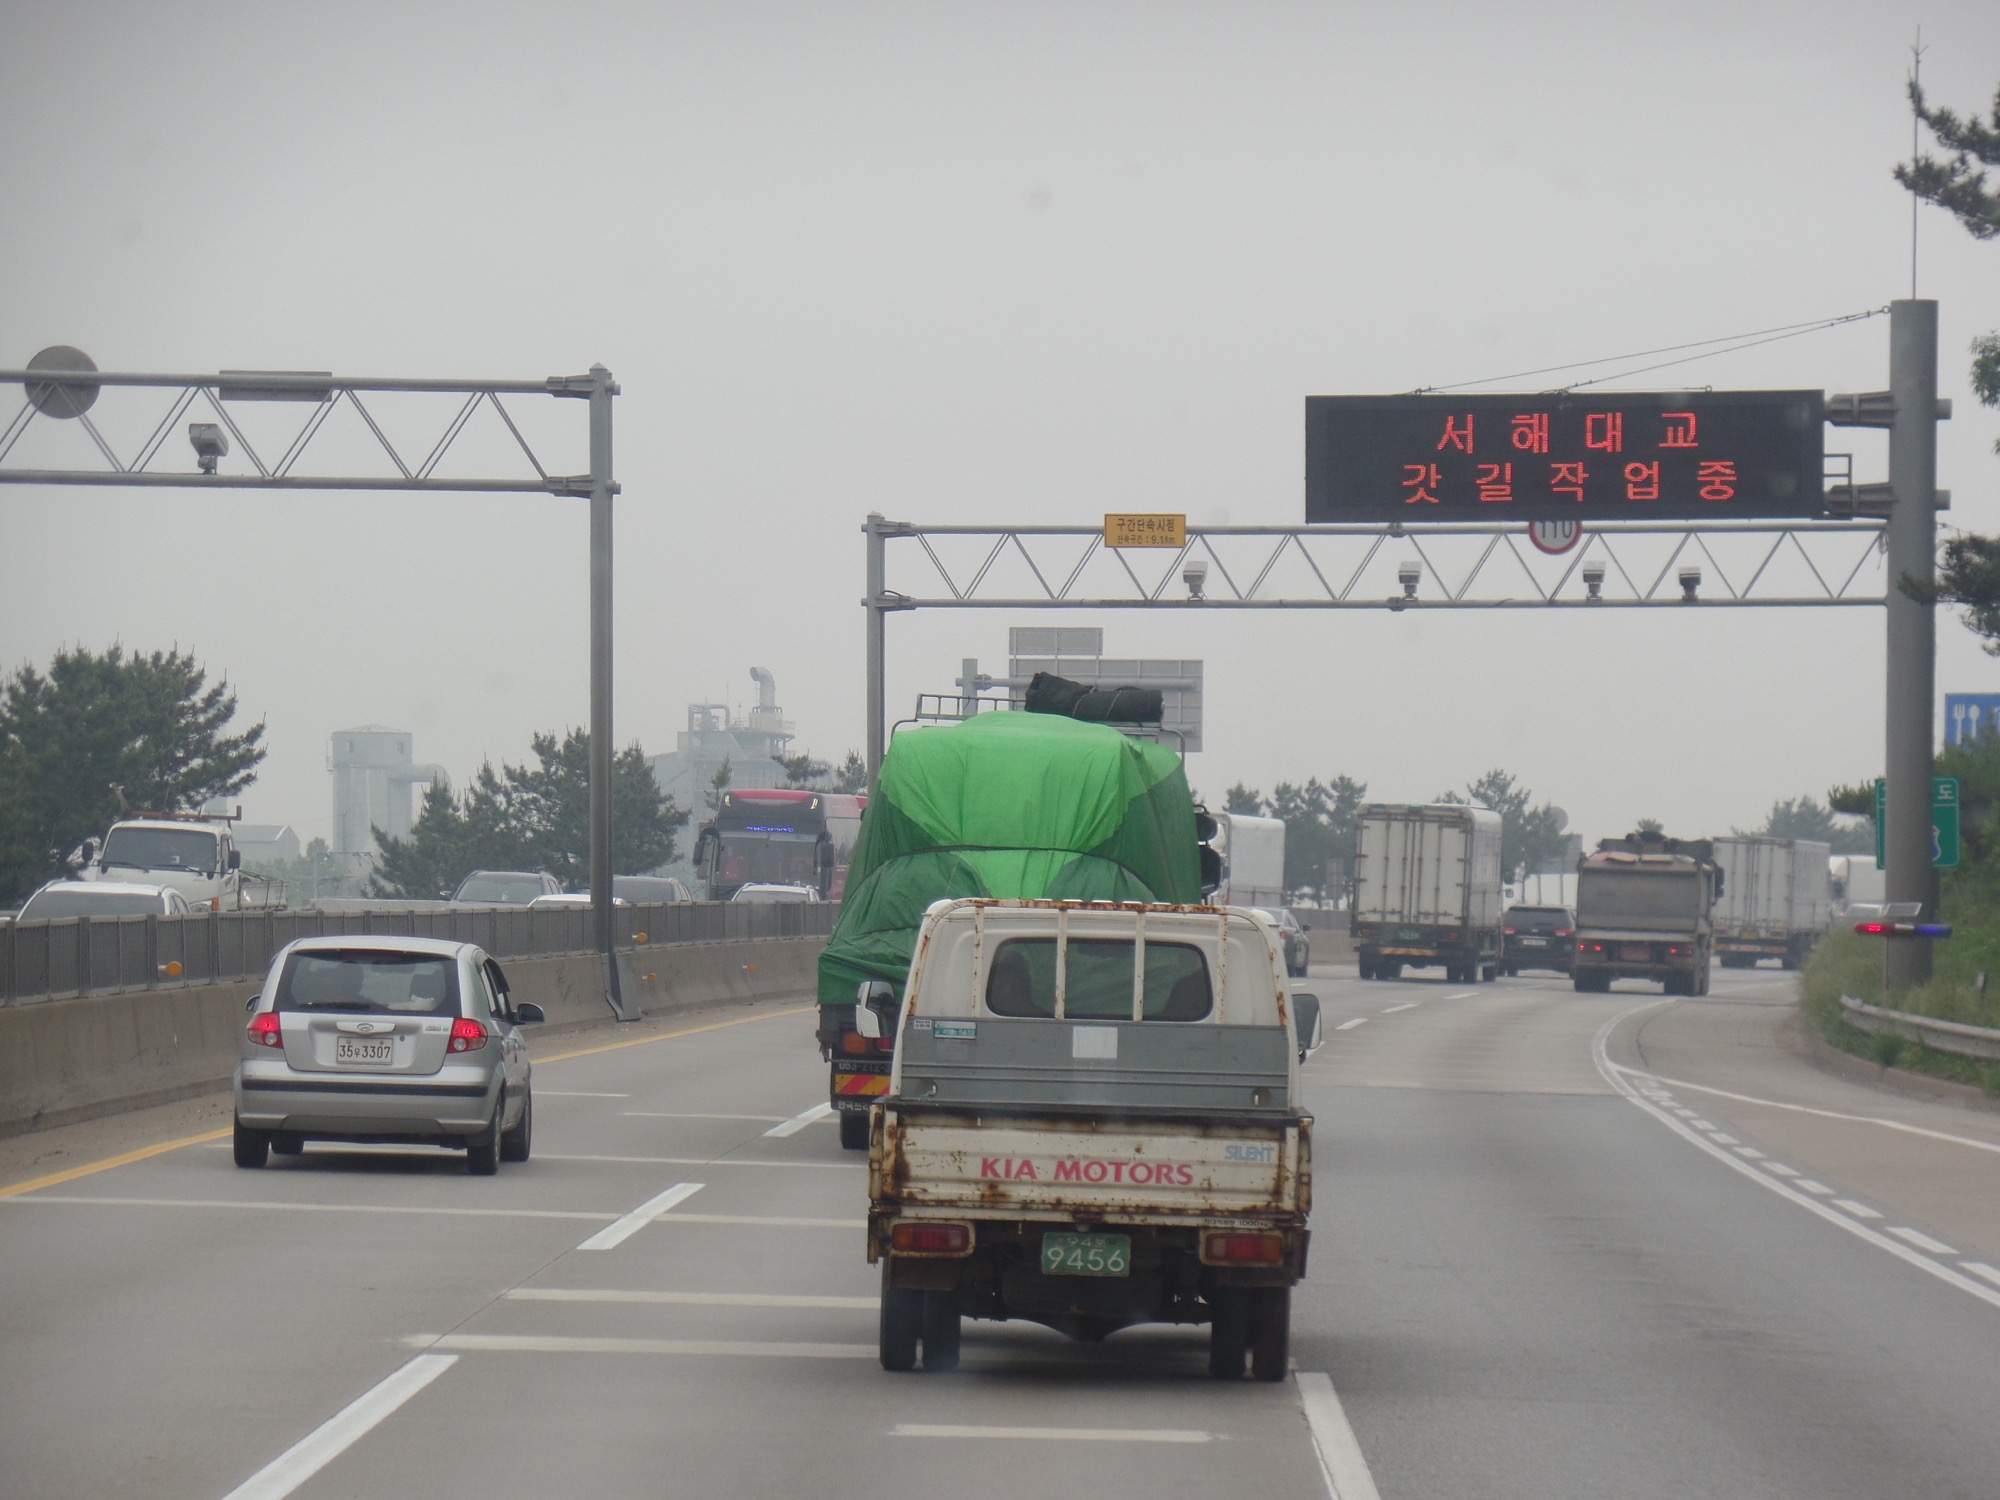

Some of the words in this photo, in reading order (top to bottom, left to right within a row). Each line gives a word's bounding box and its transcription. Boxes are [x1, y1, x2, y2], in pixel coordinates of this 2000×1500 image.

[1539, 520, 1573, 539] 110
[1224, 1145, 1275, 1162] SILENT
[980, 1157, 1037, 1181] KIA
[1054, 1159, 1195, 1186] MOTORS
[1047, 1247, 1125, 1272] 9456
